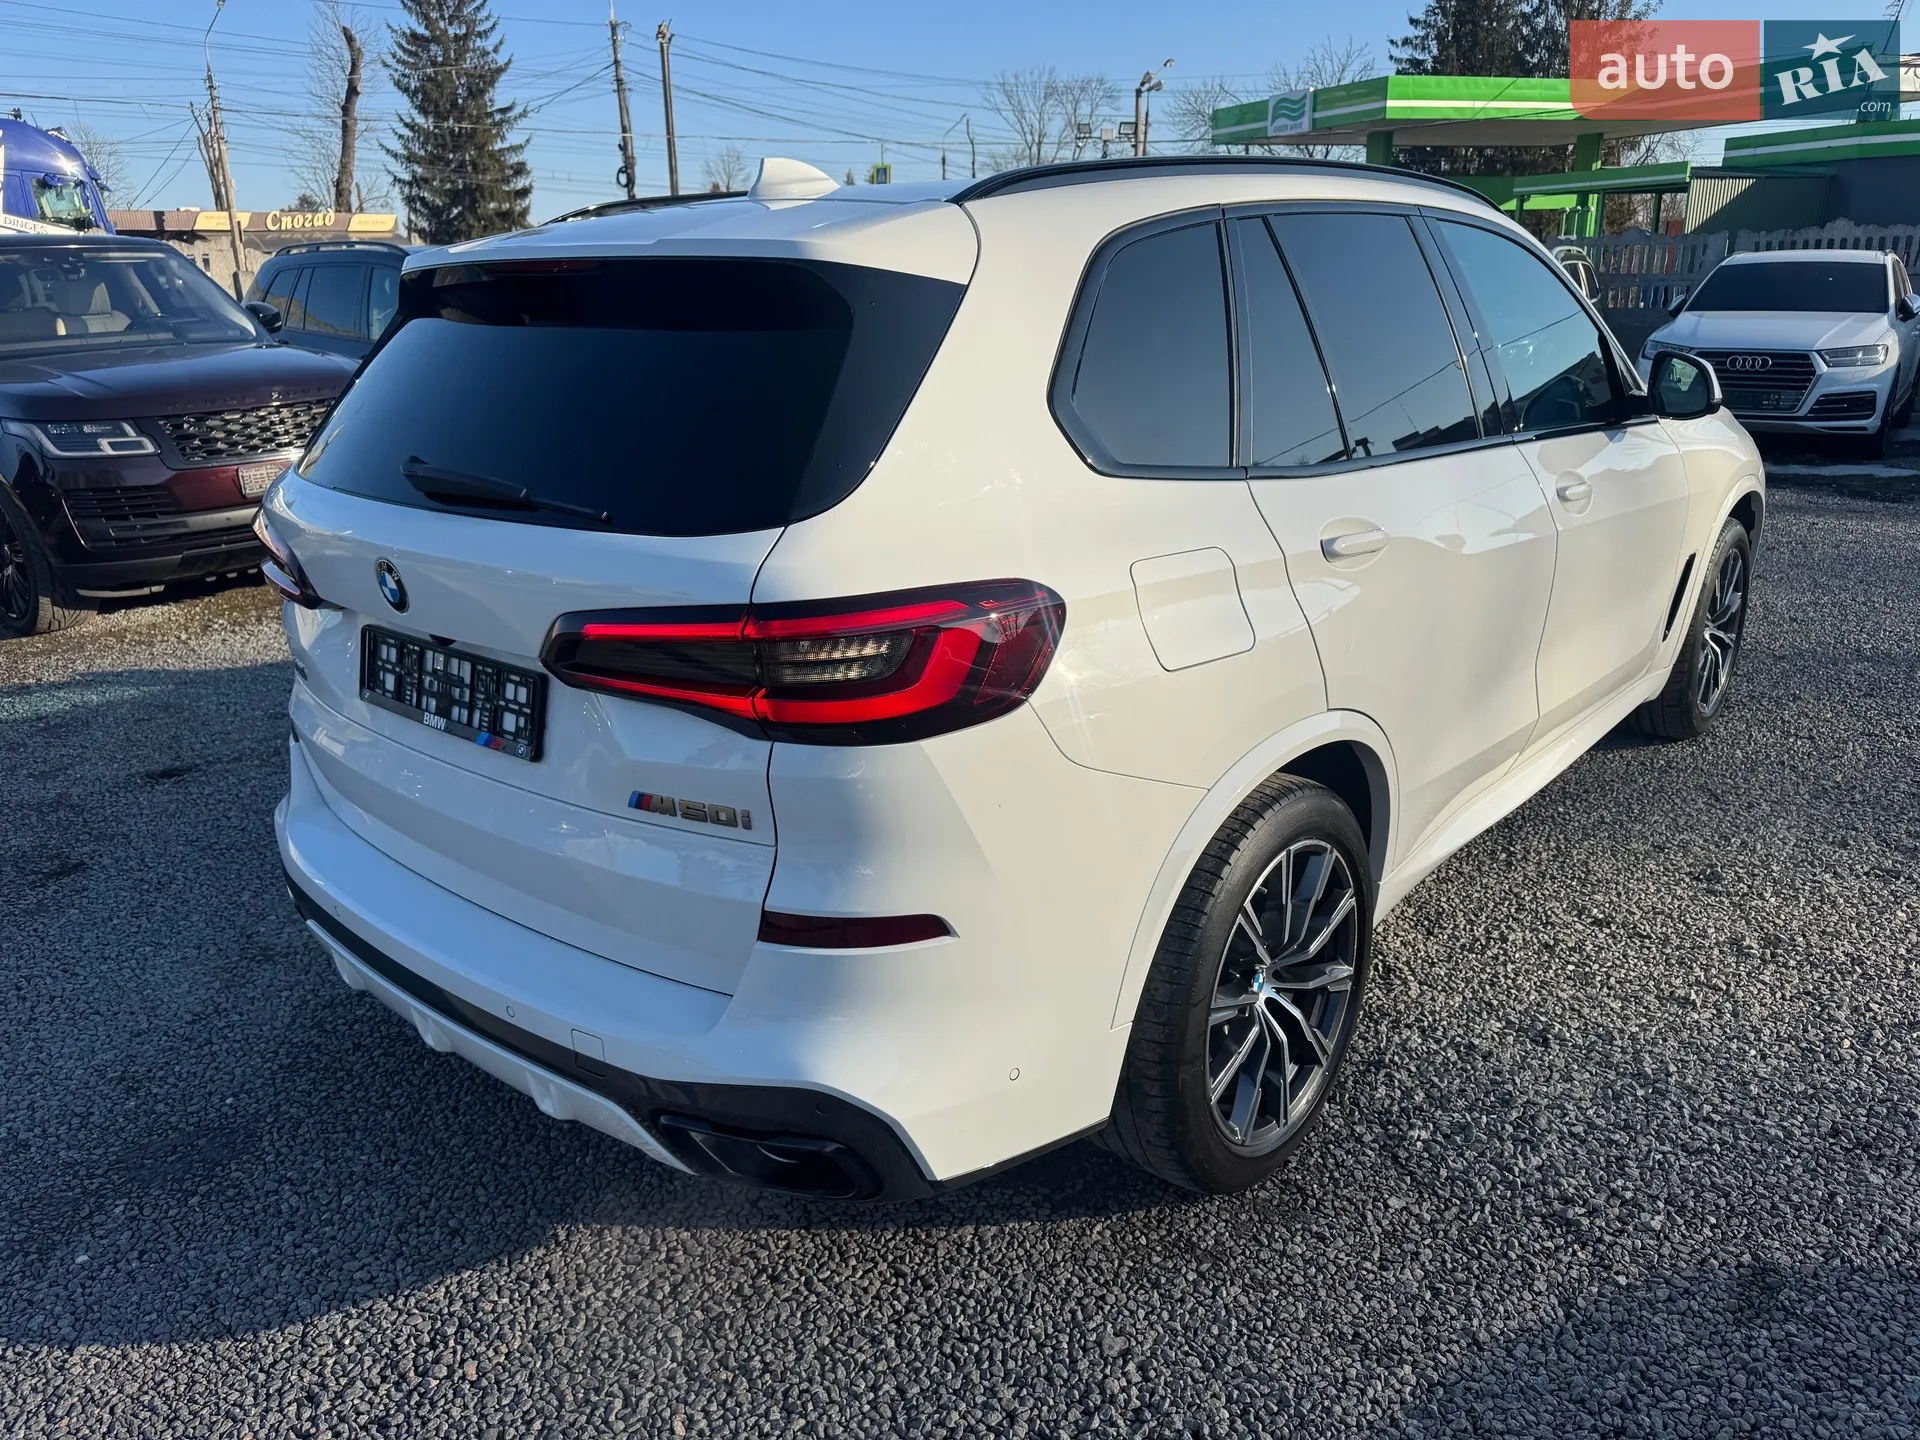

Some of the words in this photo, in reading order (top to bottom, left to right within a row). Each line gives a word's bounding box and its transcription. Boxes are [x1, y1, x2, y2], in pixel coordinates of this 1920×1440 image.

[265, 207, 335, 231] Спогад
[423, 711, 447, 731] BMW
[647, 792, 753, 831] M50i
